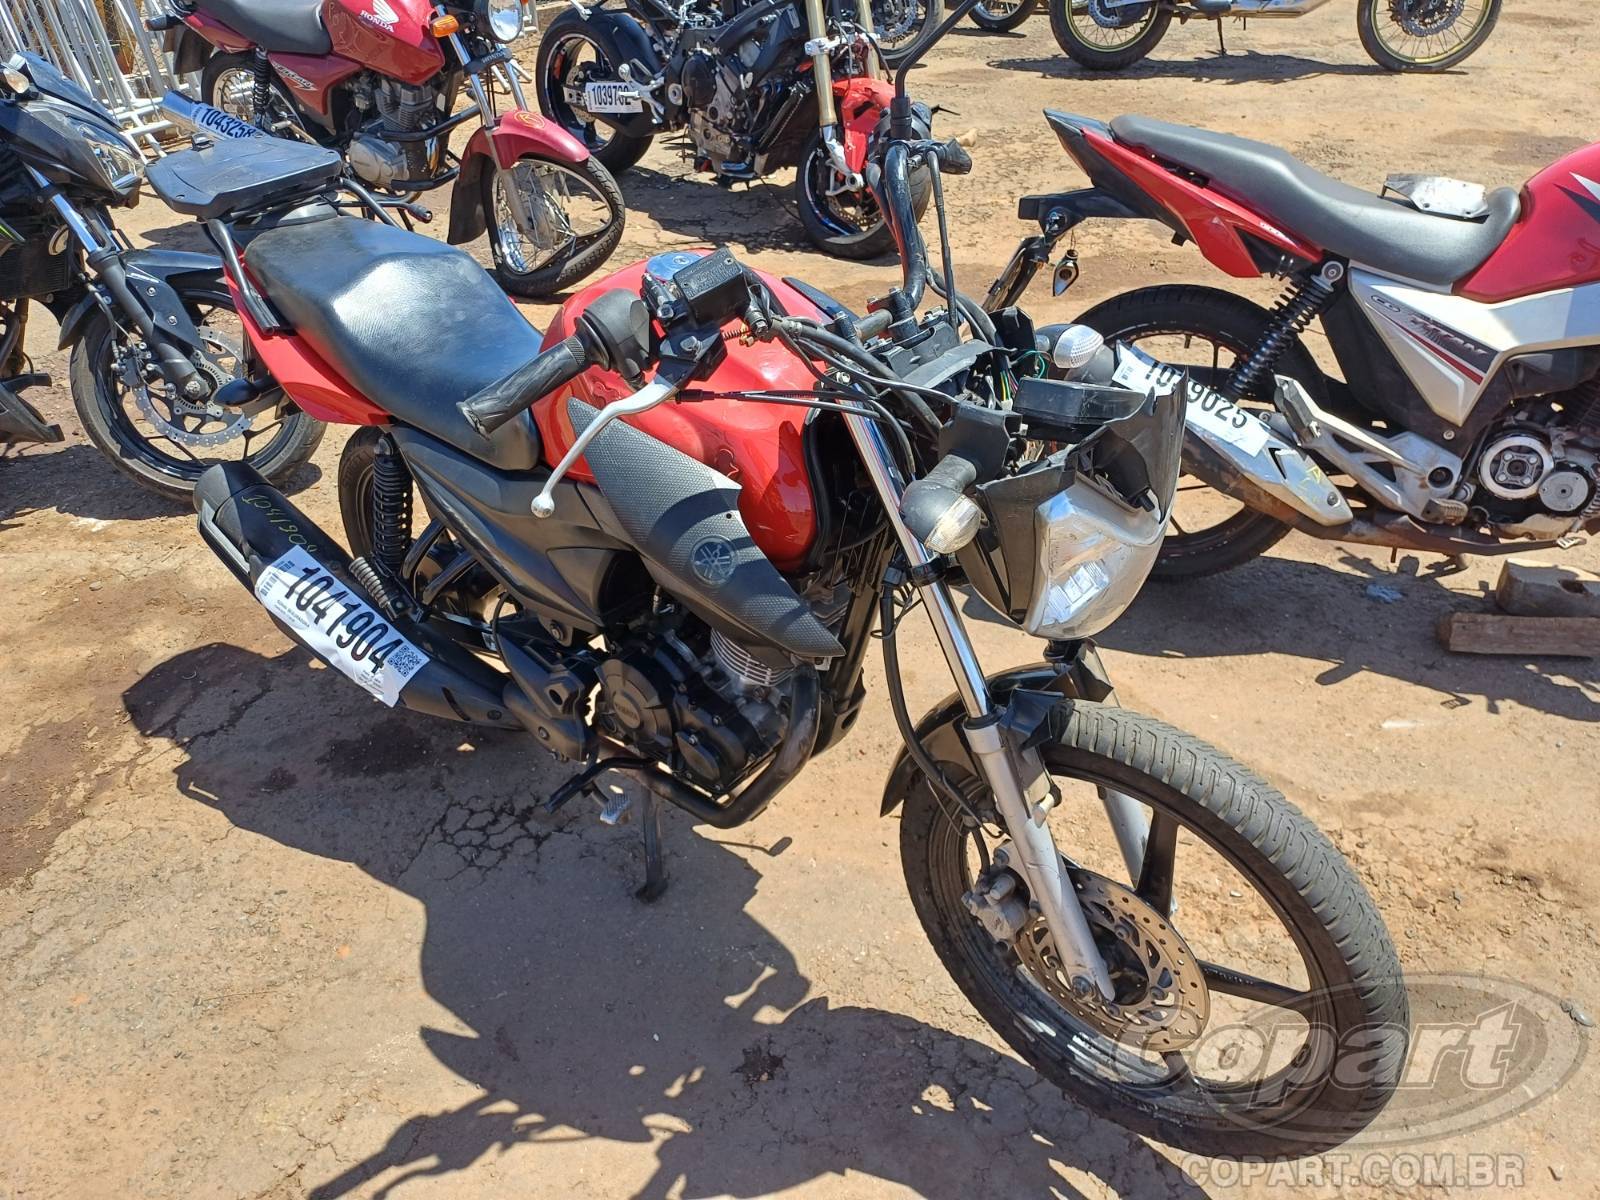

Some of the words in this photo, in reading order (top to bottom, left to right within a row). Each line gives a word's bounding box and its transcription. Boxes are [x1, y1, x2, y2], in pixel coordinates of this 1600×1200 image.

[360, 10, 394, 33] HONDA
[1145, 360, 1248, 428] 109025
[285, 566, 403, 674] 1041904
